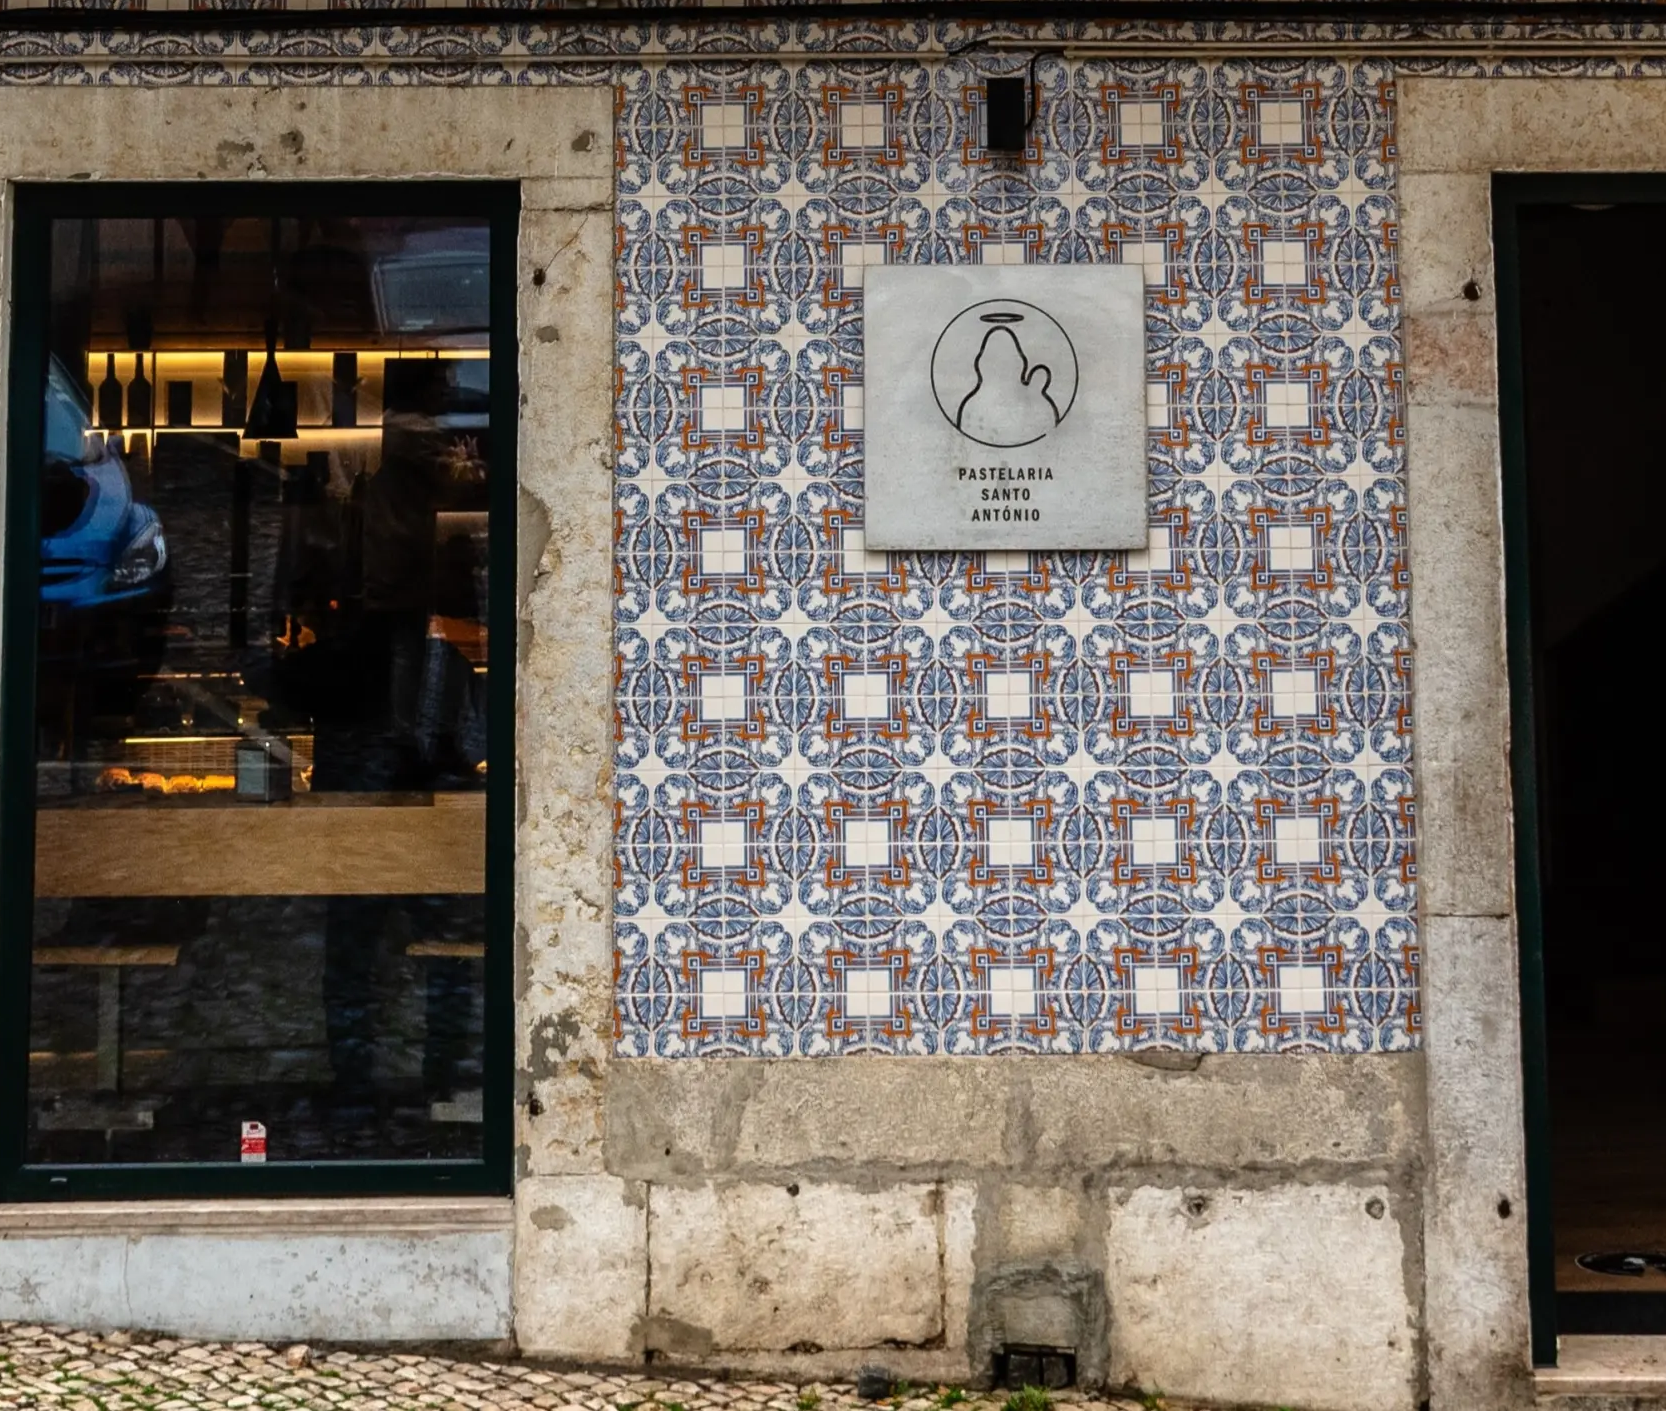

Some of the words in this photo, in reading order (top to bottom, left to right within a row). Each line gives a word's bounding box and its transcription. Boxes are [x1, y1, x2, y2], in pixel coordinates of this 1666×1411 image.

[958, 467, 1054, 481] PASTELARIA
[981, 488, 1031, 501] SANTO
[971, 506, 1040, 522] ANTÓNIO
